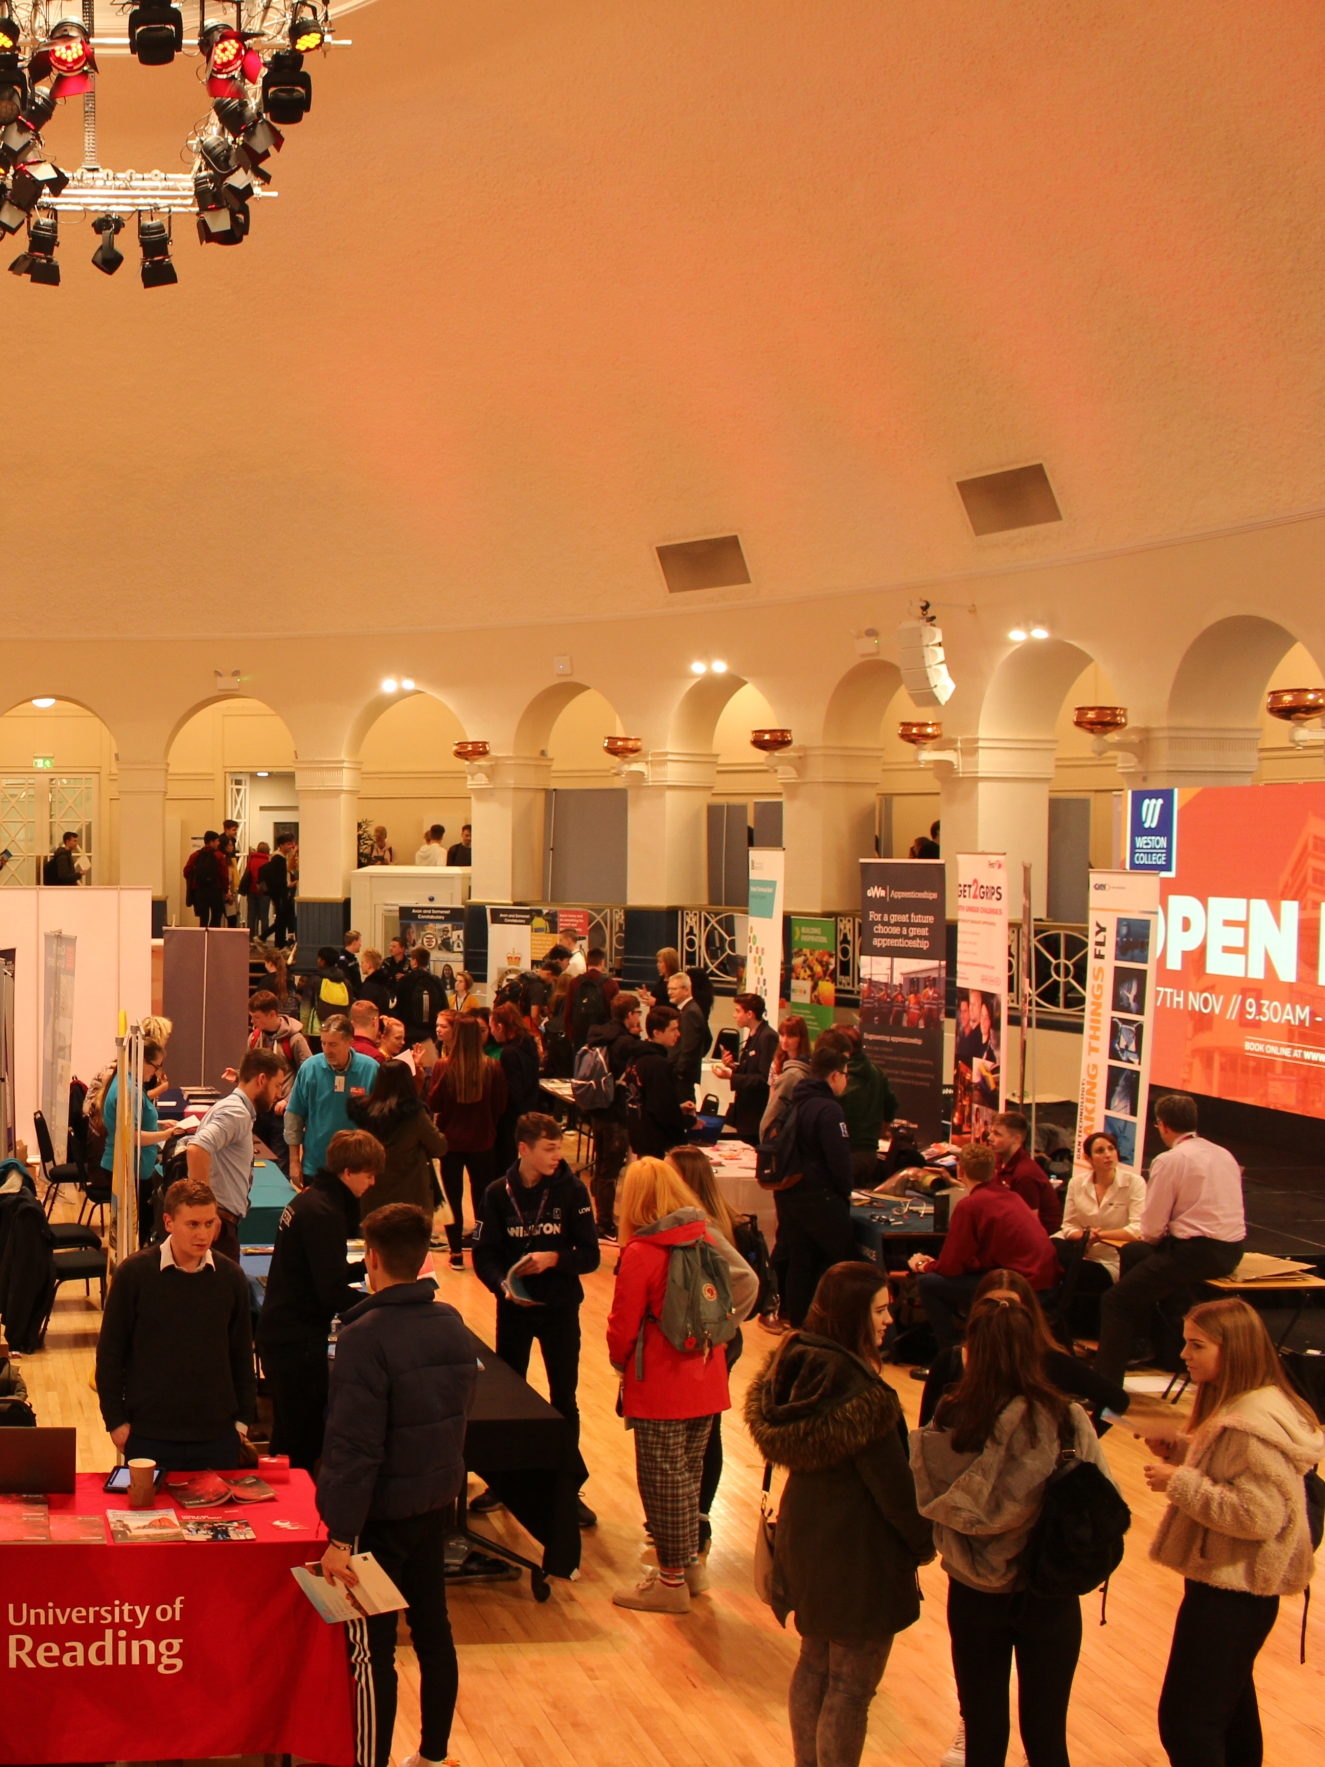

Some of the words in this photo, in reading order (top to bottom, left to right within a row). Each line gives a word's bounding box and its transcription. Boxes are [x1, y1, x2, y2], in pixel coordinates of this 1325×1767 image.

[1134, 853, 1167, 865] COLLEGE
[1135, 836, 1167, 849] WESTON
[869, 911, 882, 922] For
[883, 914, 889, 922] a
[890, 913, 910, 924] great
[911, 912, 935, 924] future
[874, 924, 901, 935] choose
[902, 927, 907, 935] a
[909, 926, 929, 937] great
[873, 937, 930, 950] apprenticeship
[1093, 920, 1107, 960] FLY
[1156, 894, 1300, 983] PEN
[1087, 966, 1105, 1057] THINGS
[1188, 991, 1224, 1015] NOV
[1245, 998, 1310, 1027] 9.30AM
[1244, 1041, 1265, 1053] BOOK
[1265, 1044, 1292, 1057] ONLINE
[1293, 1049, 1303, 1059] AT
[1083, 1063, 1099, 1150] AKING
[8, 1600, 151, 1629] University
[155, 1596, 186, 1622] of
[8, 1629, 184, 1675] Reading
